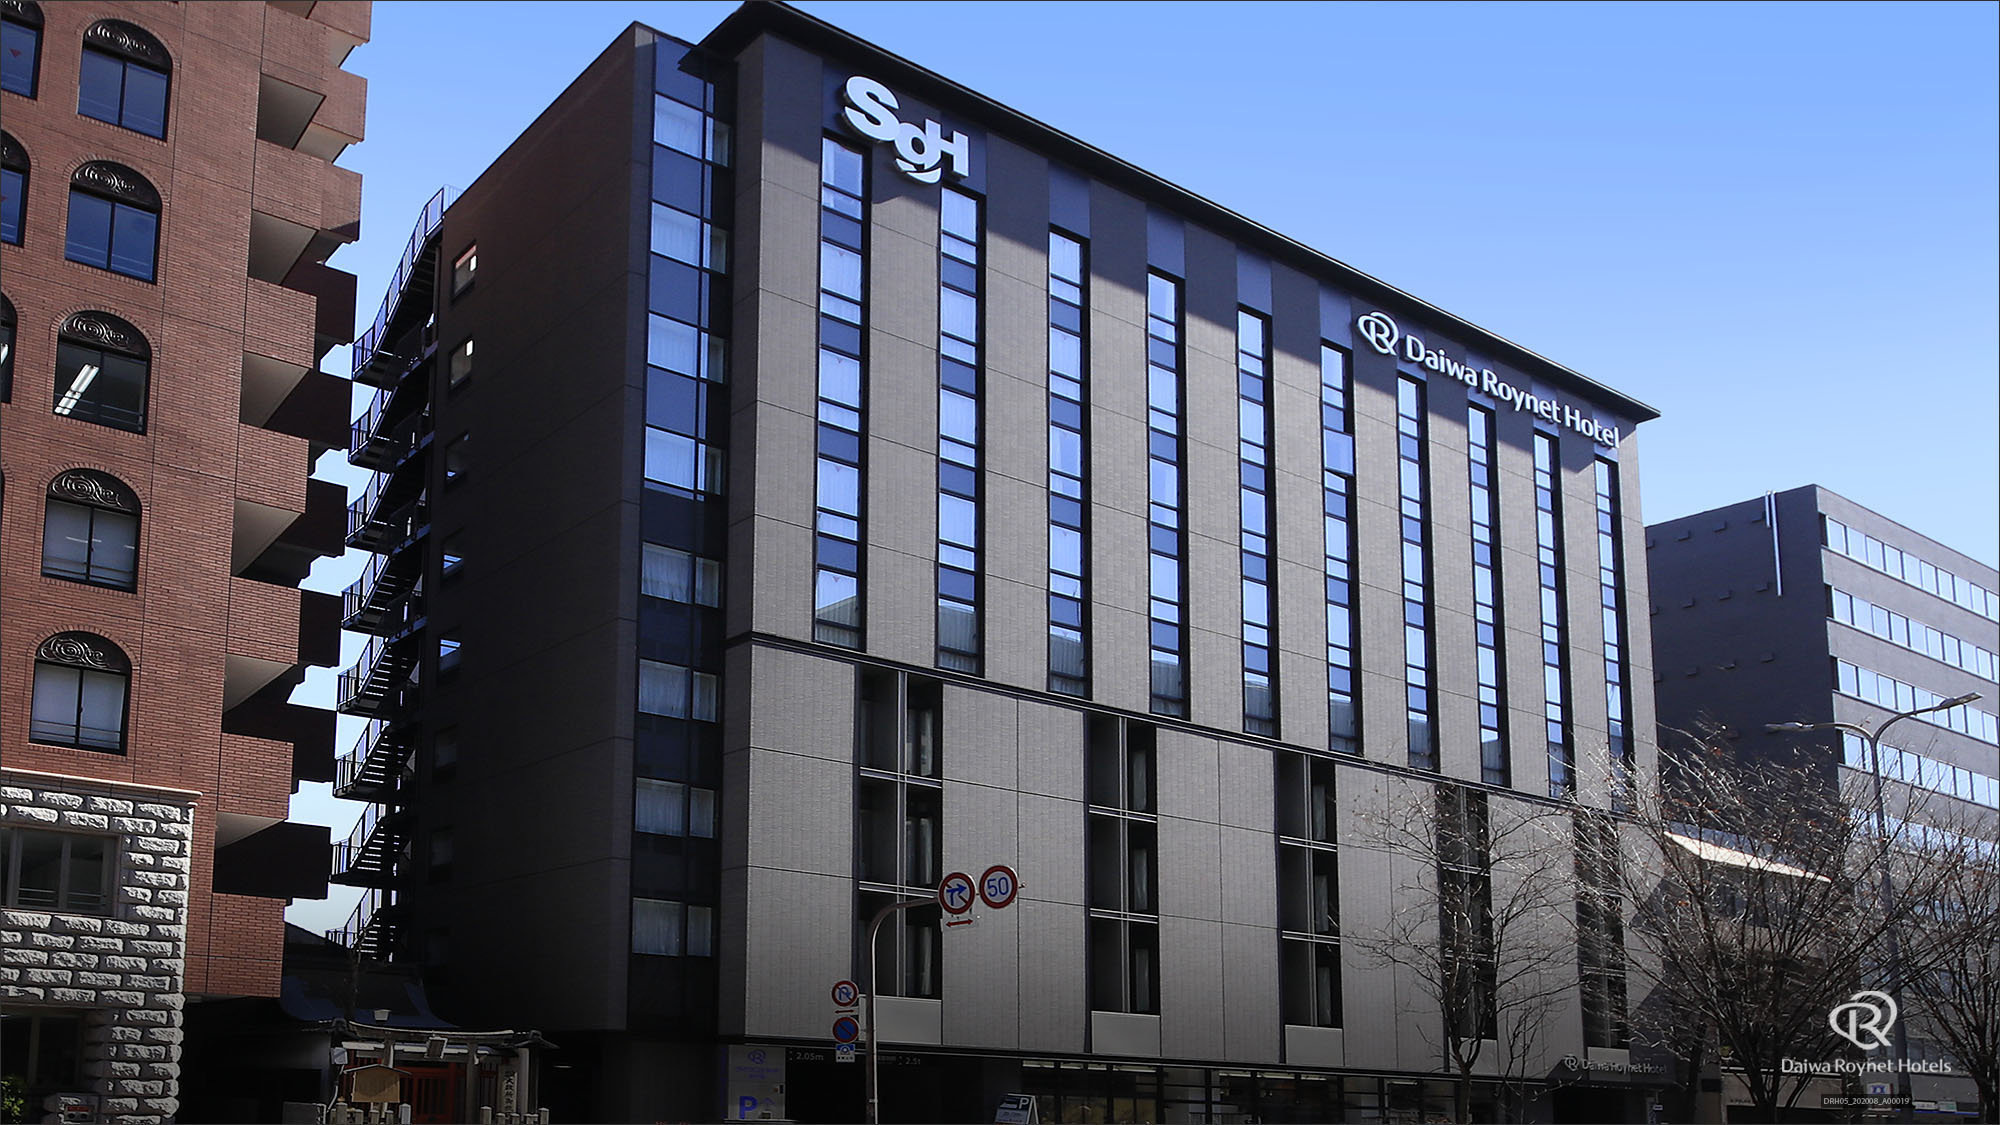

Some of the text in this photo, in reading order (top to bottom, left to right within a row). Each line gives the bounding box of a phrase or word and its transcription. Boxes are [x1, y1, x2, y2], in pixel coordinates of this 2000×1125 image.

[1405, 334, 1620, 449] Daiwa Roynet Hotel
[987, 876, 1009, 897] 50
[795, 1052, 825, 1062] 2.05m
[1643, 1062, 1668, 1074] Hotel
[739, 1096, 758, 1119] P
[1018, 1096, 1030, 1110] P
